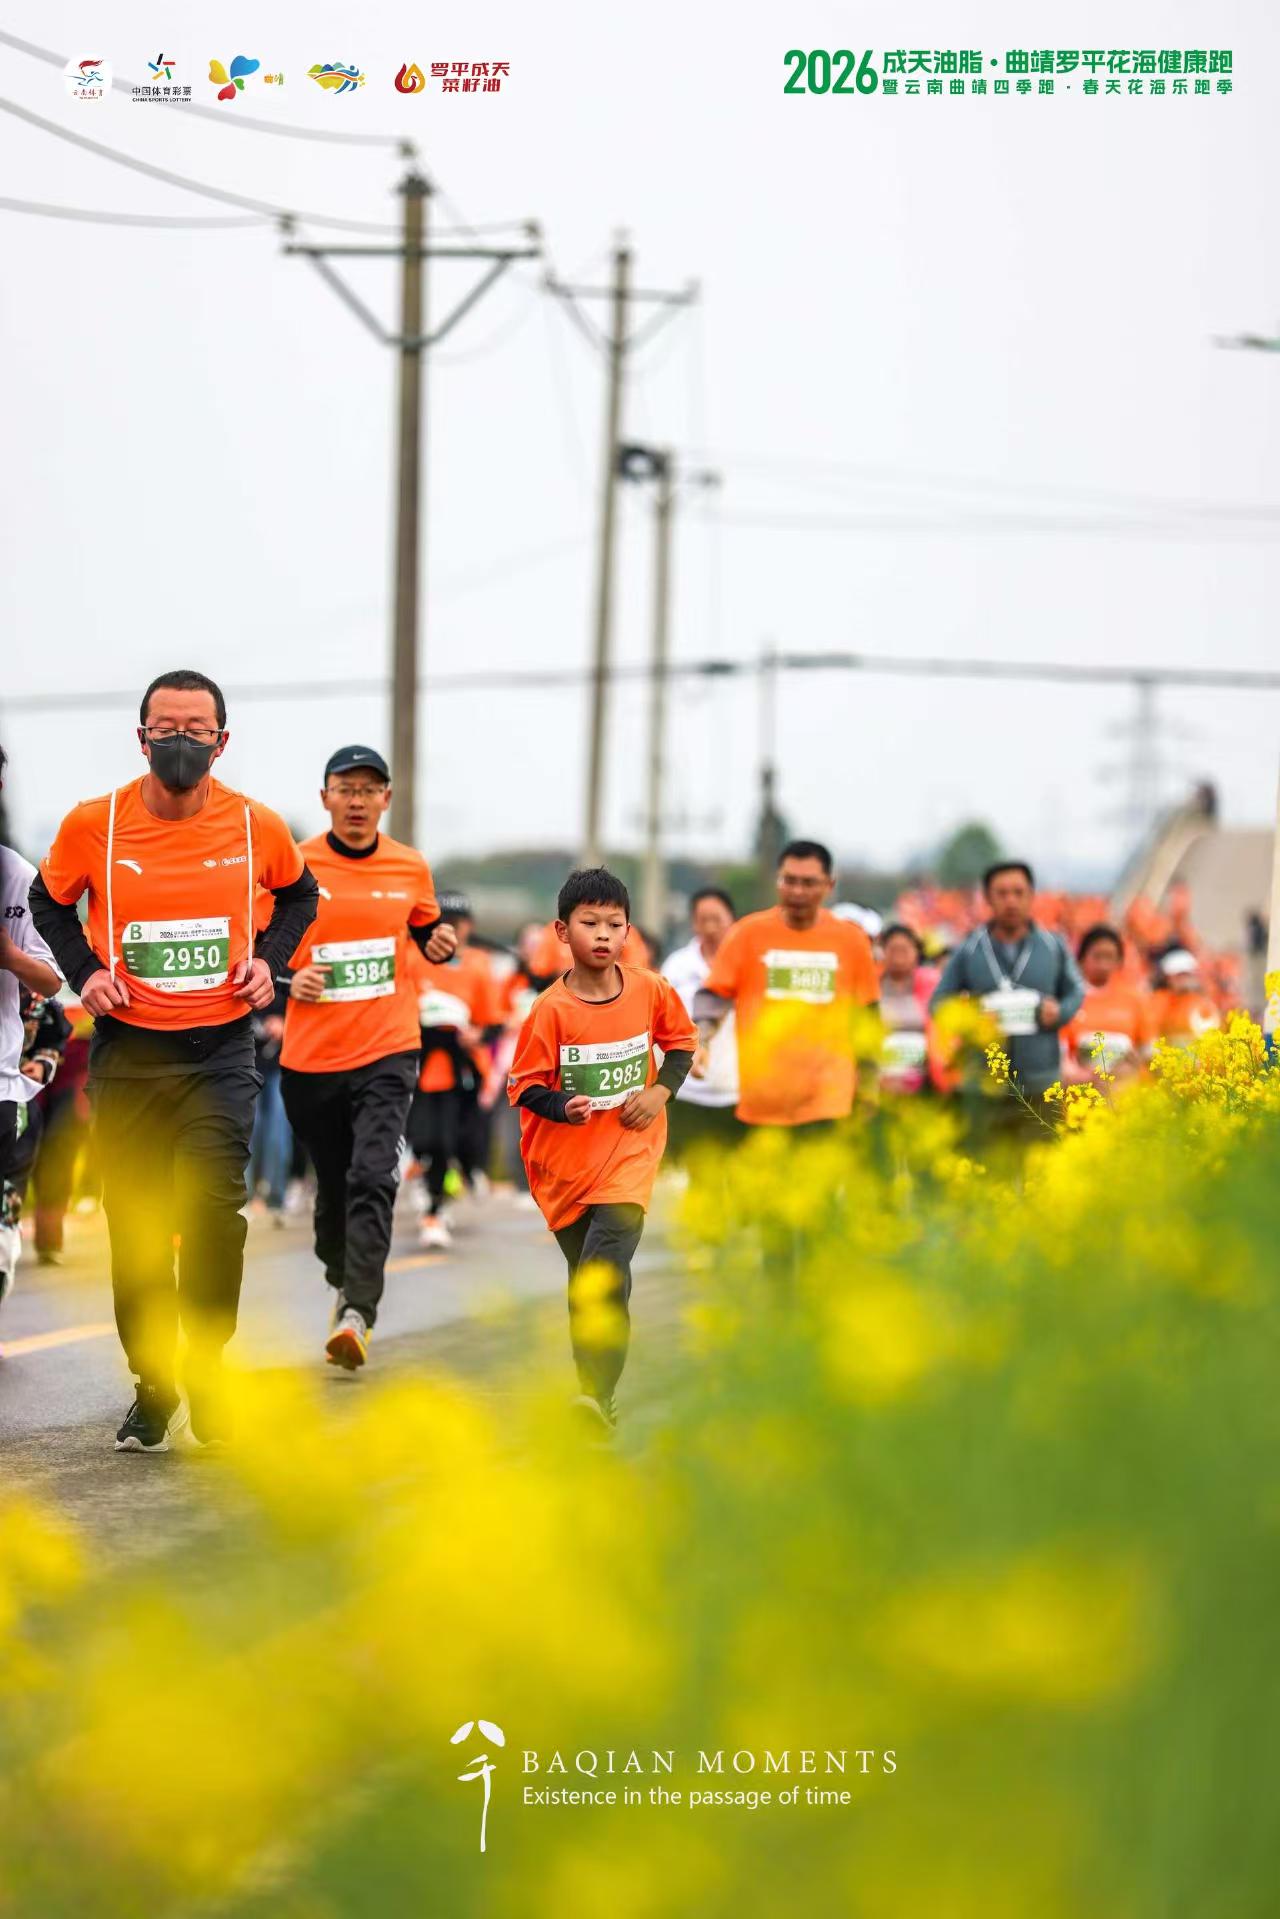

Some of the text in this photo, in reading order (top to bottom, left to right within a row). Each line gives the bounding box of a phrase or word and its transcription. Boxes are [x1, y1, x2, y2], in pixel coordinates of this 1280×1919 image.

[130, 924, 142, 940] B
[162, 945, 220, 971] 2950
[344, 960, 390, 984] 5984
[568, 1047, 580, 1062] B
[599, 1060, 642, 1090] 2985
